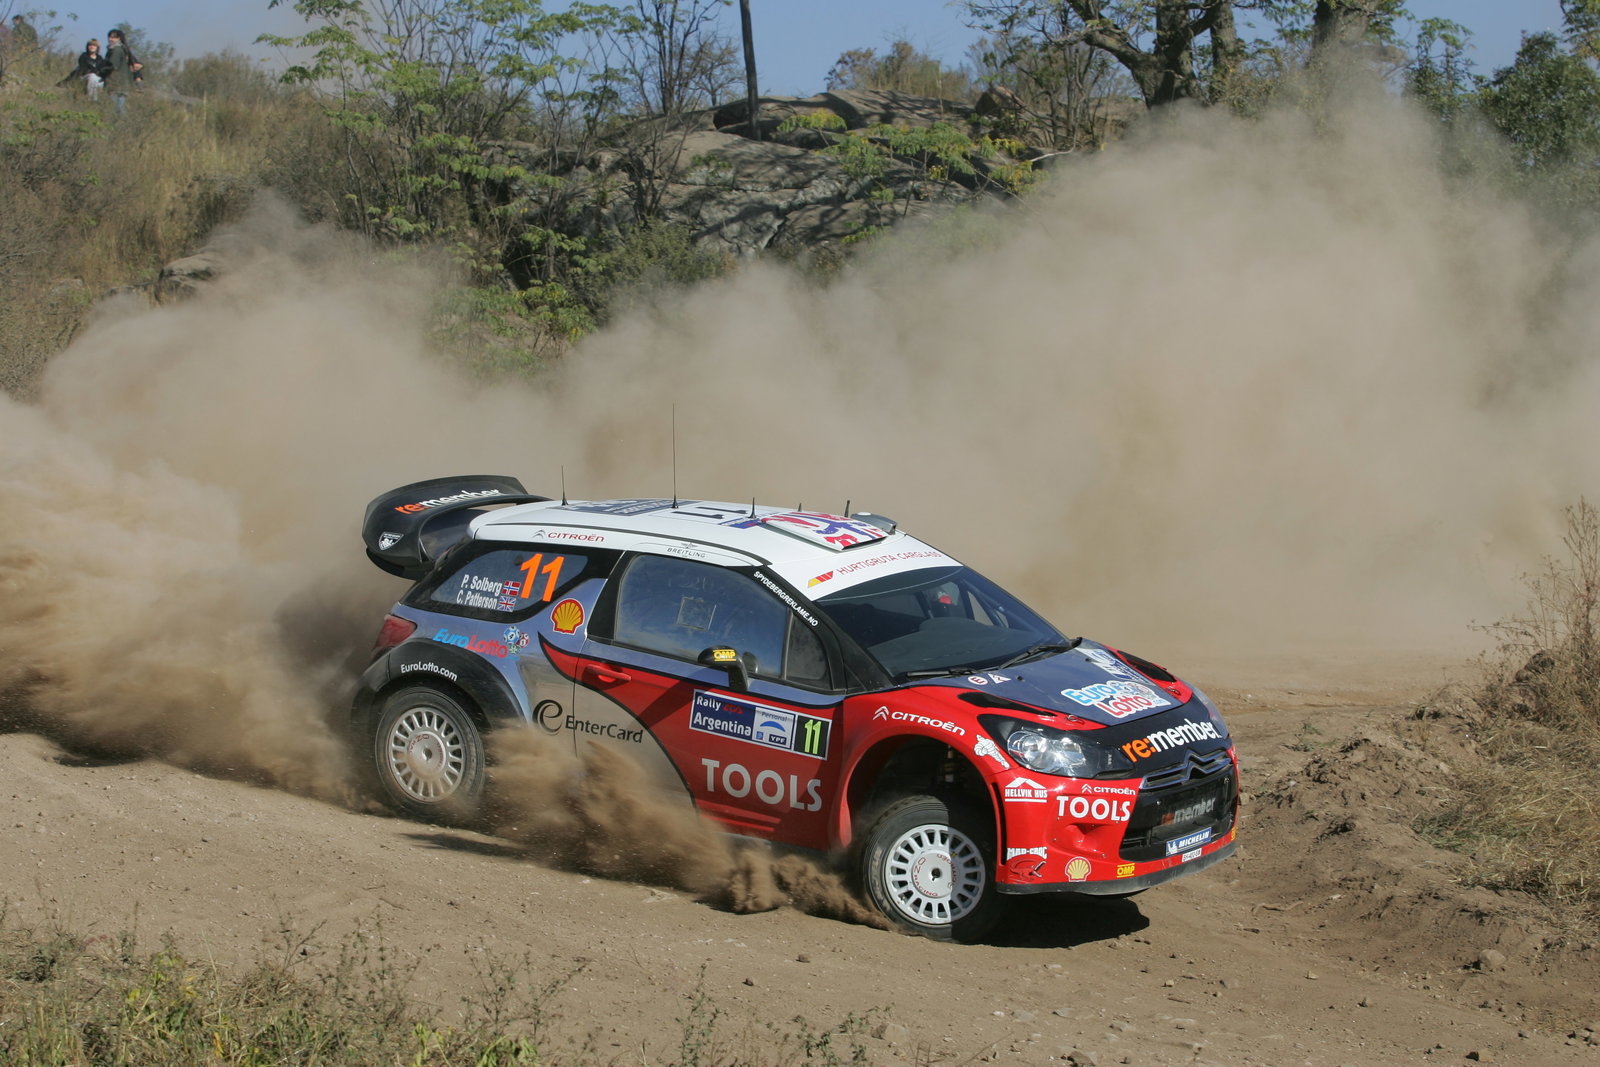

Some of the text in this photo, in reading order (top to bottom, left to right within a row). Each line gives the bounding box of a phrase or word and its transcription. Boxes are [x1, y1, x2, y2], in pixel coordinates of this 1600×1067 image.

[667, 547, 706, 559] BREITLING
[837, 554, 898, 575] HURTIGRUTA
[461, 574, 503, 597] P. Solberg
[520, 553, 565, 602] 11
[456, 589, 498, 610] C. Patterson
[753, 570, 819, 628] SPYDEBERGREKLAME.NO
[432, 628, 508, 658] EuroLotto
[713, 651, 736, 659] OMP
[400, 661, 458, 681] EuroLotto.com
[696, 695, 721, 711] Rally
[1064, 685, 1117, 704] Euro
[762, 711, 787, 721] Personal
[1096, 695, 1153, 716] Lotto
[565, 714, 643, 744] EnterCard
[693, 712, 752, 737] Argentina
[770, 735, 786, 744] YPF
[804, 719, 822, 755] 11
[1121, 718, 1221, 763] re:member
[701, 757, 823, 812] TOOLS
[1004, 788, 1048, 799] HELLVIK HUS
[1056, 795, 1131, 822] TOOLS
[1178, 831, 1210, 848] MICHELIN
[1117, 866, 1136, 876] OMP
